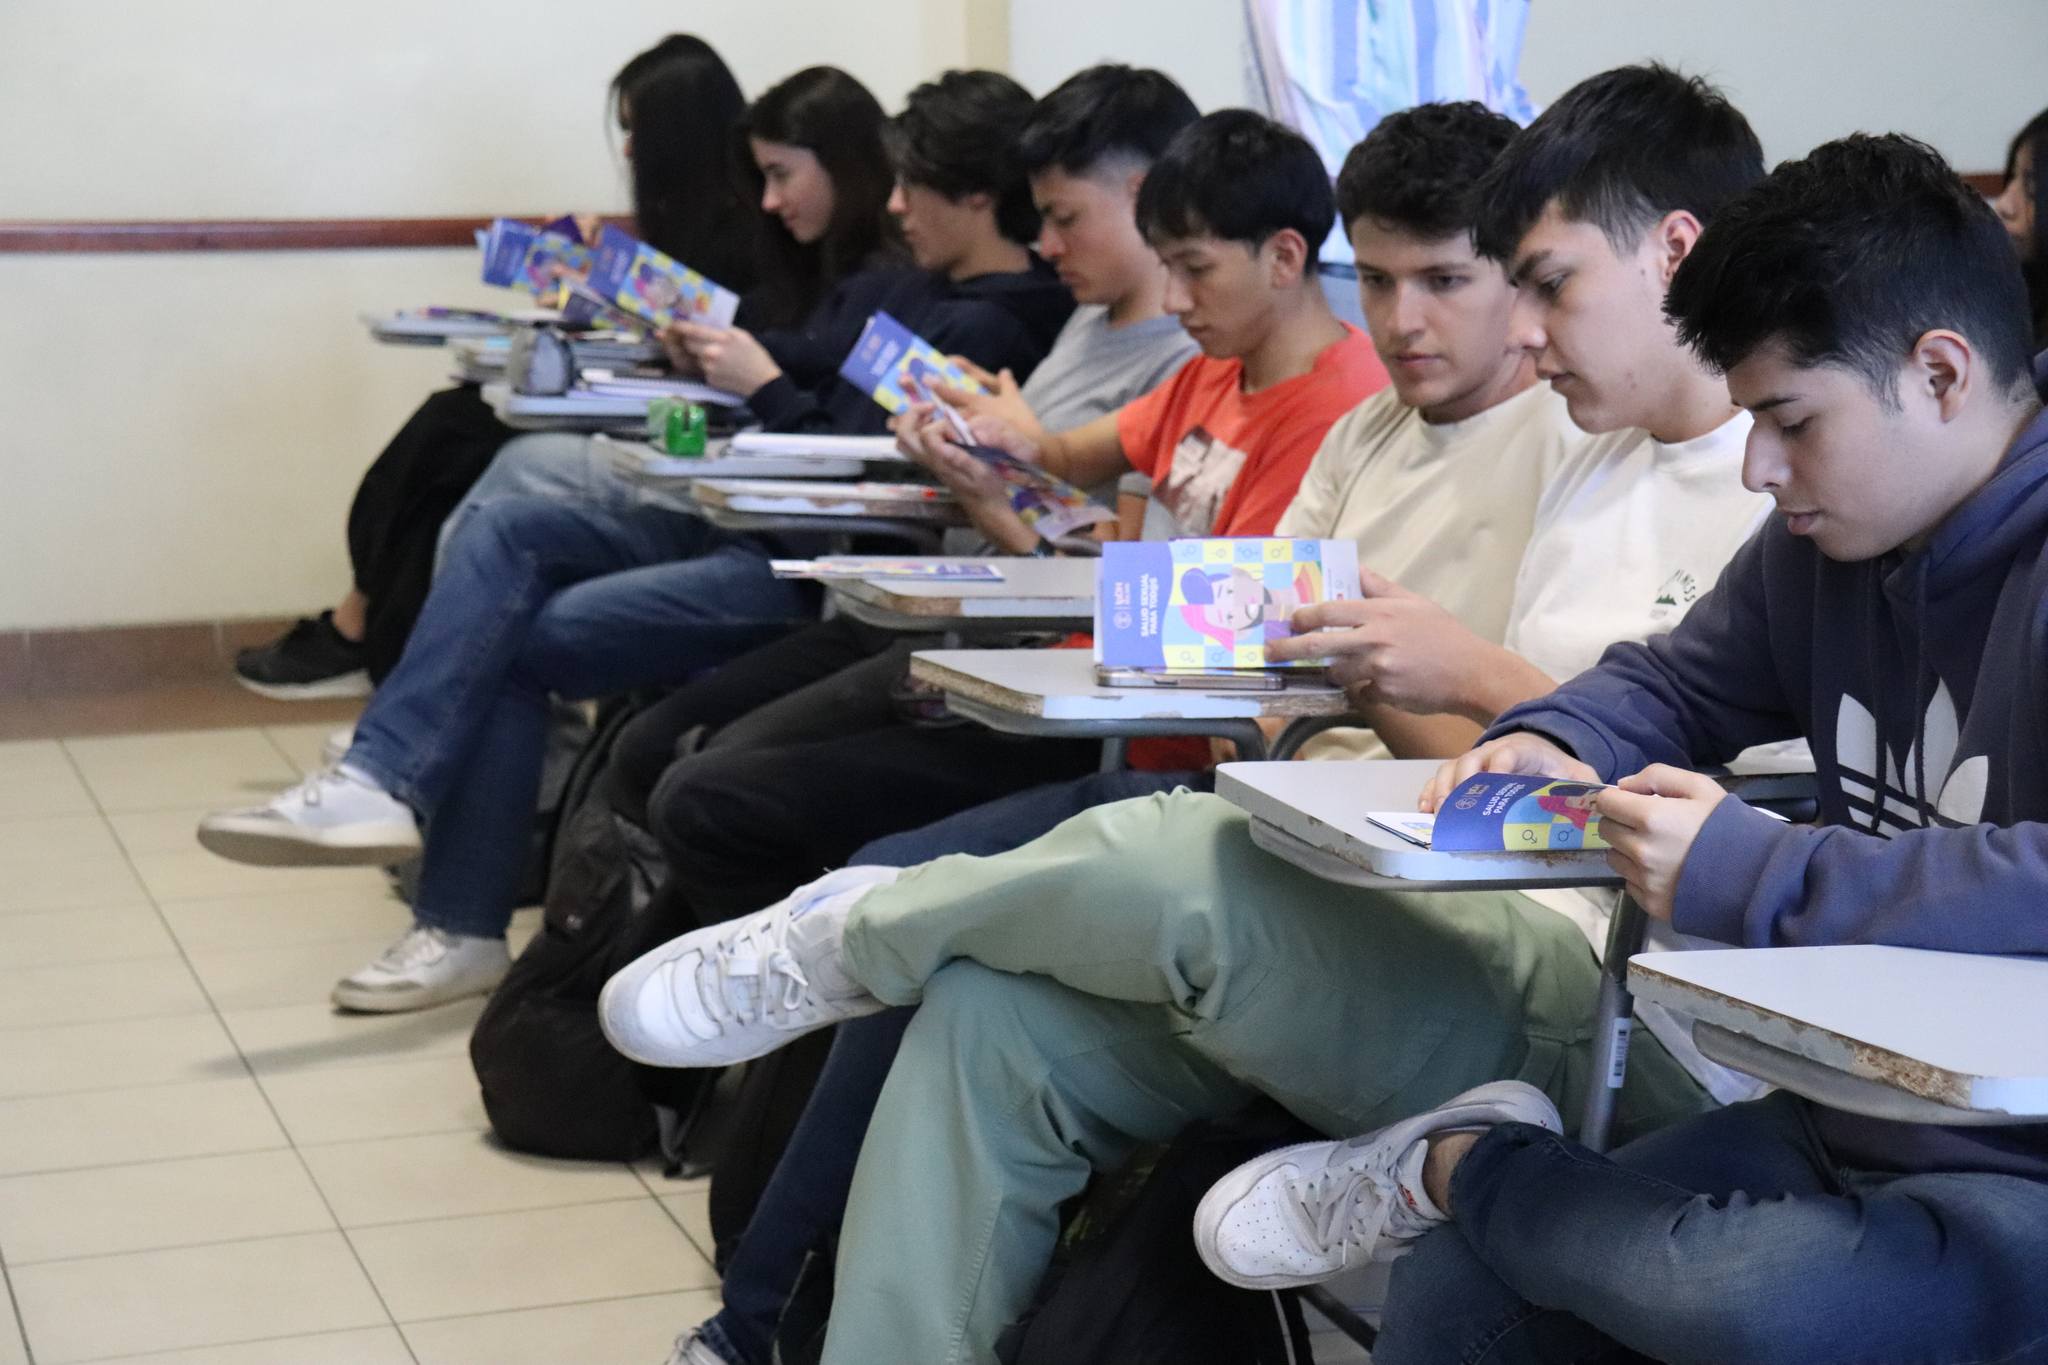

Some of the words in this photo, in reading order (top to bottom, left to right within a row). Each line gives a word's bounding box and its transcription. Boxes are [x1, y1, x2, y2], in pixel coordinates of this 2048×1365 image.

[1140, 607, 1149, 637] SALUD
[1482, 796, 1500, 816] SALUD
[1493, 797, 1510, 814] PARA
